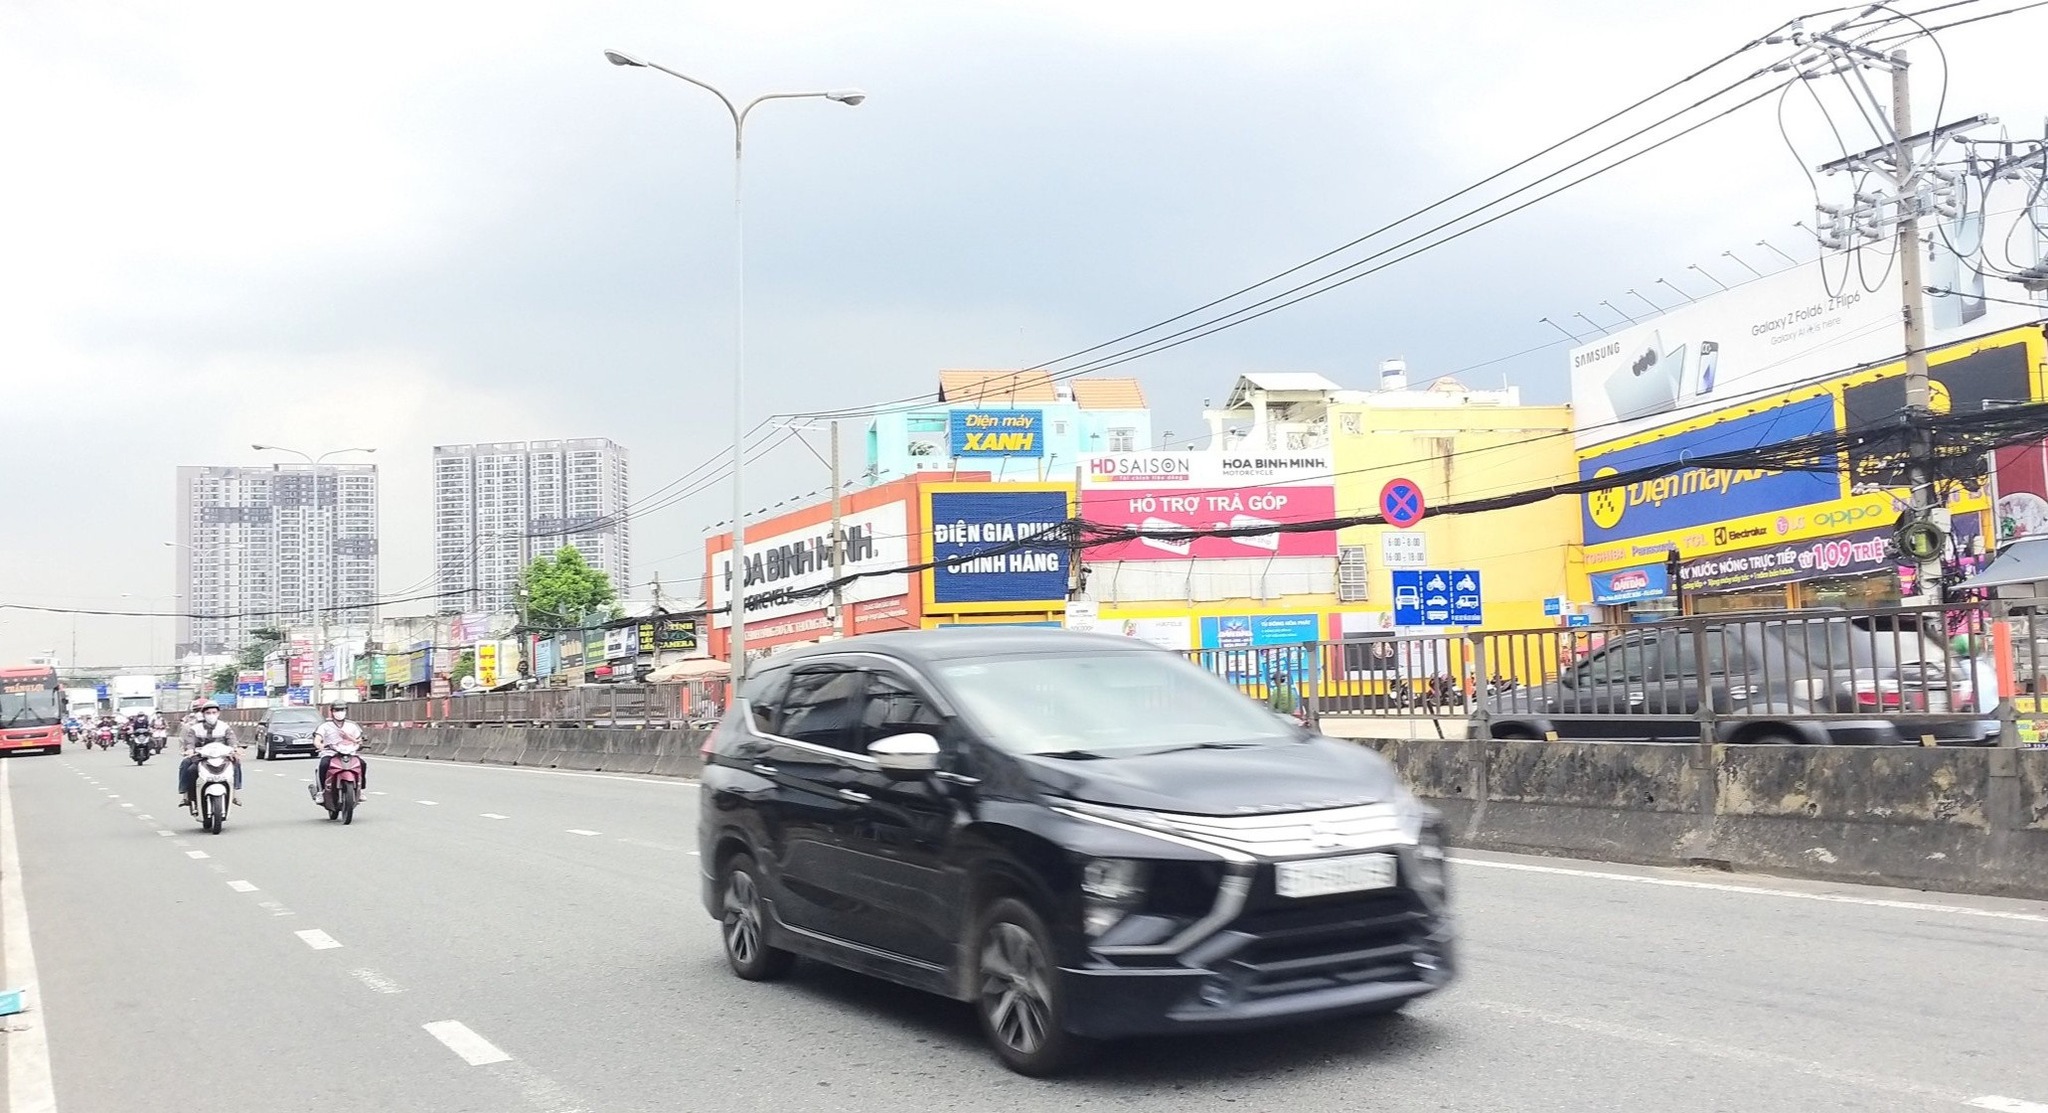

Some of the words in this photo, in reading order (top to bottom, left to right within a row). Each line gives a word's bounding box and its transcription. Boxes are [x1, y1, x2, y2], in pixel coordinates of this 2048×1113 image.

[1751, 317, 1787, 336] Galaxy
[1788, 312, 1794, 325] Z
[1795, 304, 1823, 322] Fold6
[1828, 299, 1835, 311] Z
[1836, 290, 1861, 309] Flip6
[1770, 332, 1797, 345] Galaxy
[1574, 341, 1620, 368] SAMSUNG
[965, 414, 998, 429] Điện
[1002, 414, 1034, 429] máy
[962, 432, 1034, 451] XANH
[1091, 458, 1116, 474] HD
[1118, 457, 1190, 474] SAISON
[1222, 458, 1253, 469] HOA
[1255, 458, 1288, 469] BINH
[1129, 493, 1156, 513] HỖ
[1159, 495, 1200, 516] TRỢ
[1205, 492, 1244, 512] TRẢ
[1248, 491, 1288, 511] GÓP
[934, 519, 980, 547] ĐIỆN
[983, 523, 1016, 542] GIA
[1583, 548, 1626, 565] TOSHIBA
[1728, 526, 1768, 541] Electrolux
[766, 538, 814, 582] BINH
[1009, 550, 1060, 573] HÃNG
[1720, 556, 1749, 574] NÓNG
[1776, 546, 1798, 565] TIẾP
[1852, 536, 1891, 564] TRIỆ
